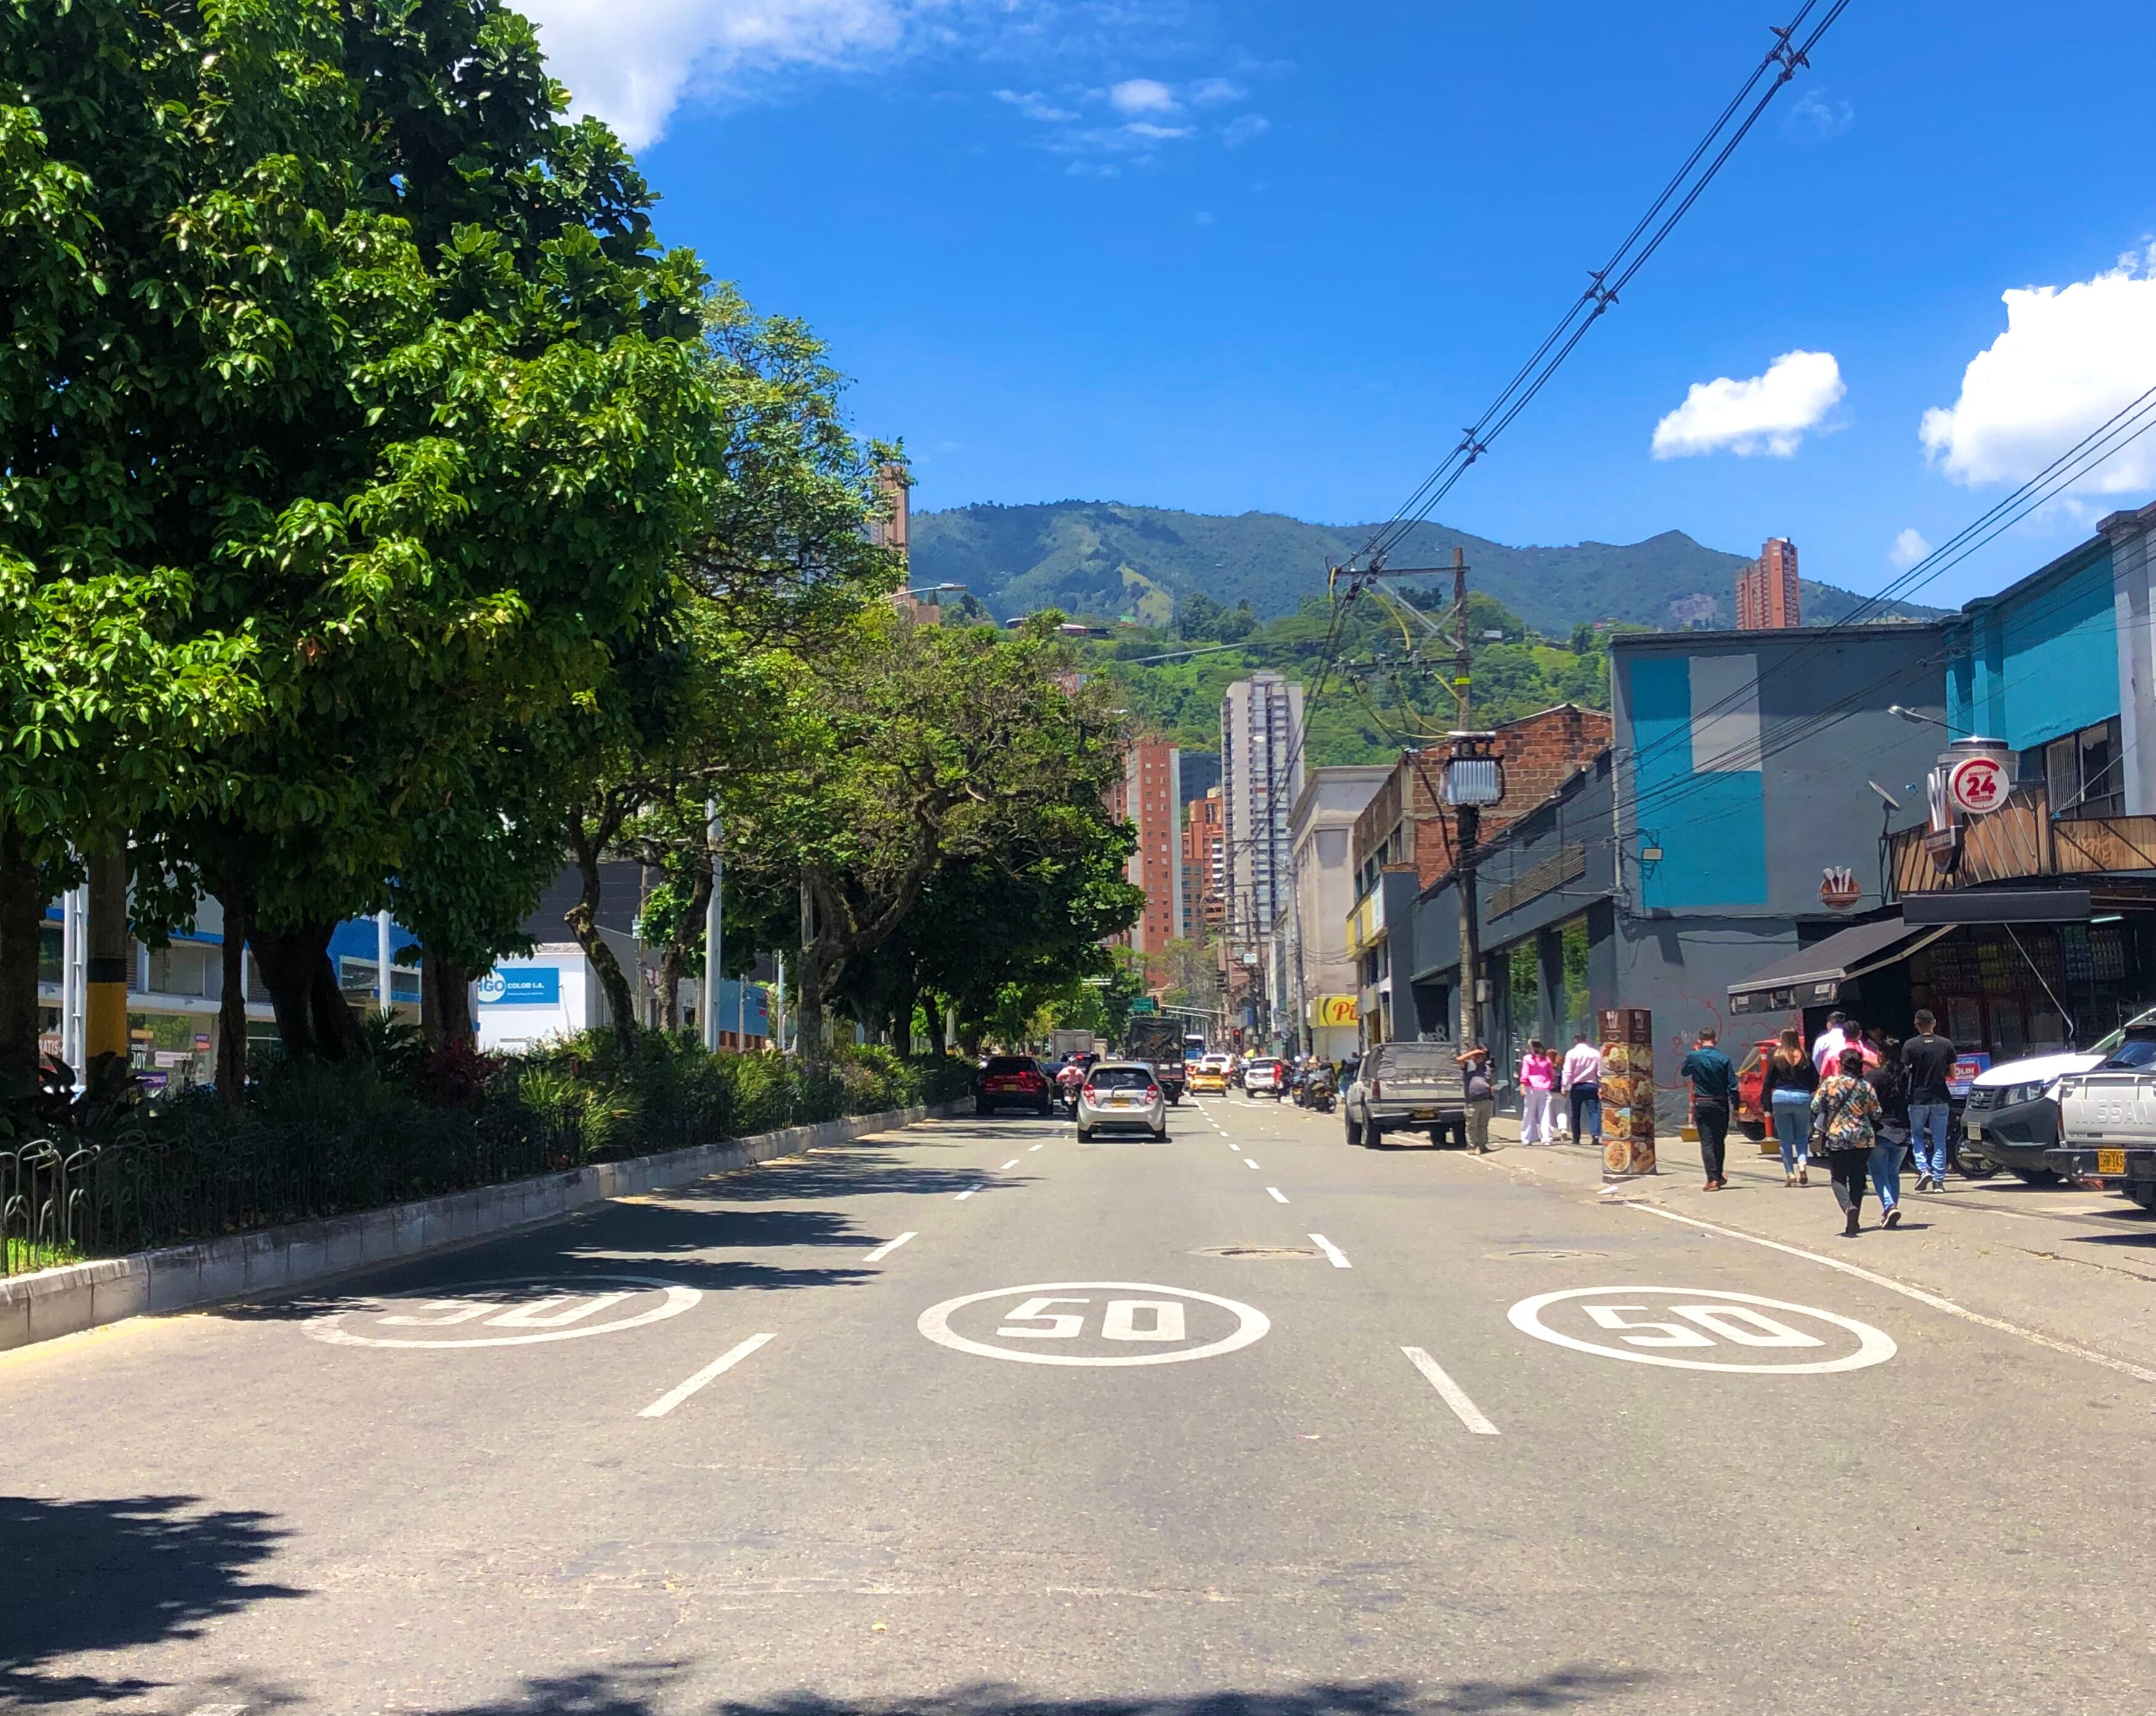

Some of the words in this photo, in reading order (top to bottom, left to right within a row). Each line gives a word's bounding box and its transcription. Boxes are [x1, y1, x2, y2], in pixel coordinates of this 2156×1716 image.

[1966, 775, 1996, 796] 24
[131, 1051, 147, 1070] JOY
[2075, 1099, 2153, 1125] NISSAN
[996, 1297, 1186, 1342] 50
[1581, 1305, 1826, 1347] 50
